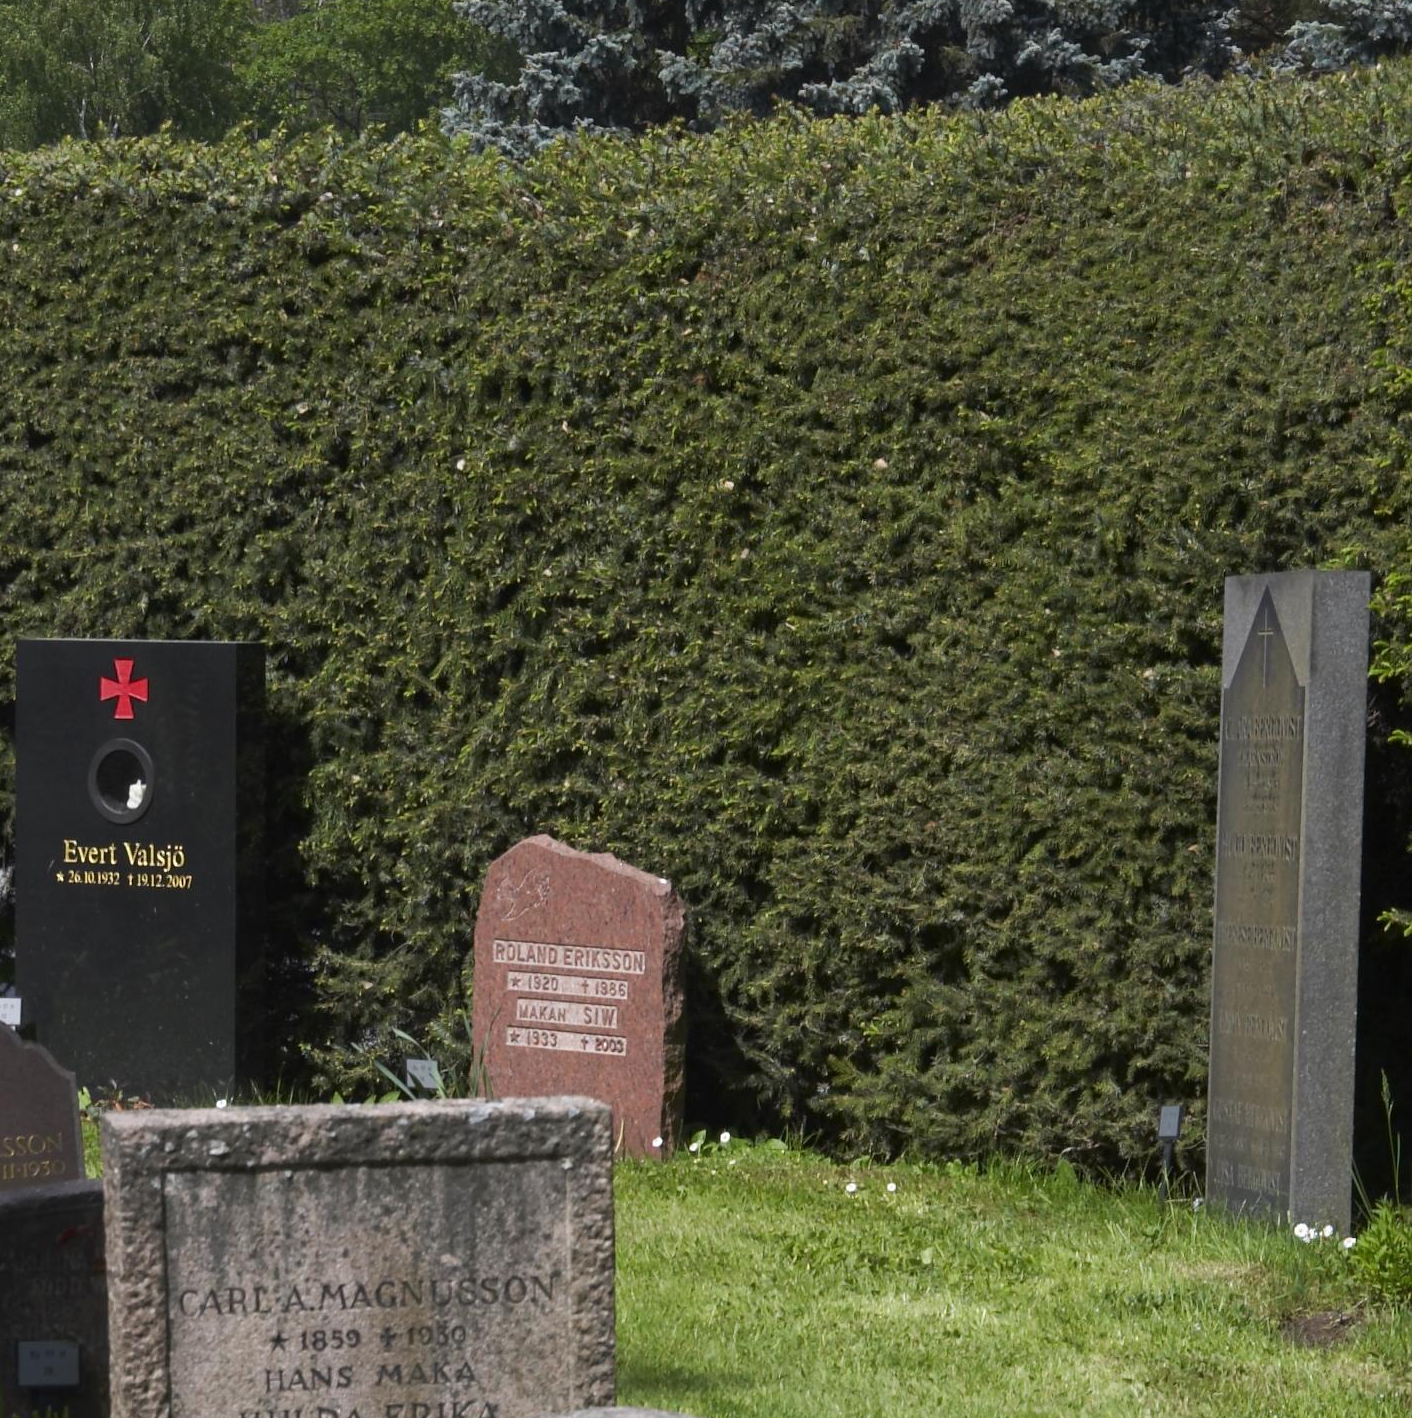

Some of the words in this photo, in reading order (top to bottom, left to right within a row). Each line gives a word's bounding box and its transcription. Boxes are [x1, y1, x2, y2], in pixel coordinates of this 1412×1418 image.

[63, 839, 117, 865] Evert
[124, 842, 185, 872] Valsjö
[68, 870, 120, 885] 26.10.1932
[136, 873, 192, 889] 19.12.2007
[495, 942, 557, 965] ROLAND
[564, 949, 644, 972] ERIKSSON
[528, 976, 558, 991] 1920
[519, 1005, 566, 1021] MAKAN
[584, 1008, 616, 1026] SIW
[527, 1031, 557, 1047] 1933
[595, 1038, 624, 1053] 2003
[179, 1287, 272, 1317] CARL
[301, 1329, 361, 1351] 1859
[266, 1366, 353, 1393] HANS
[376, 1362, 476, 1388] MAKA
